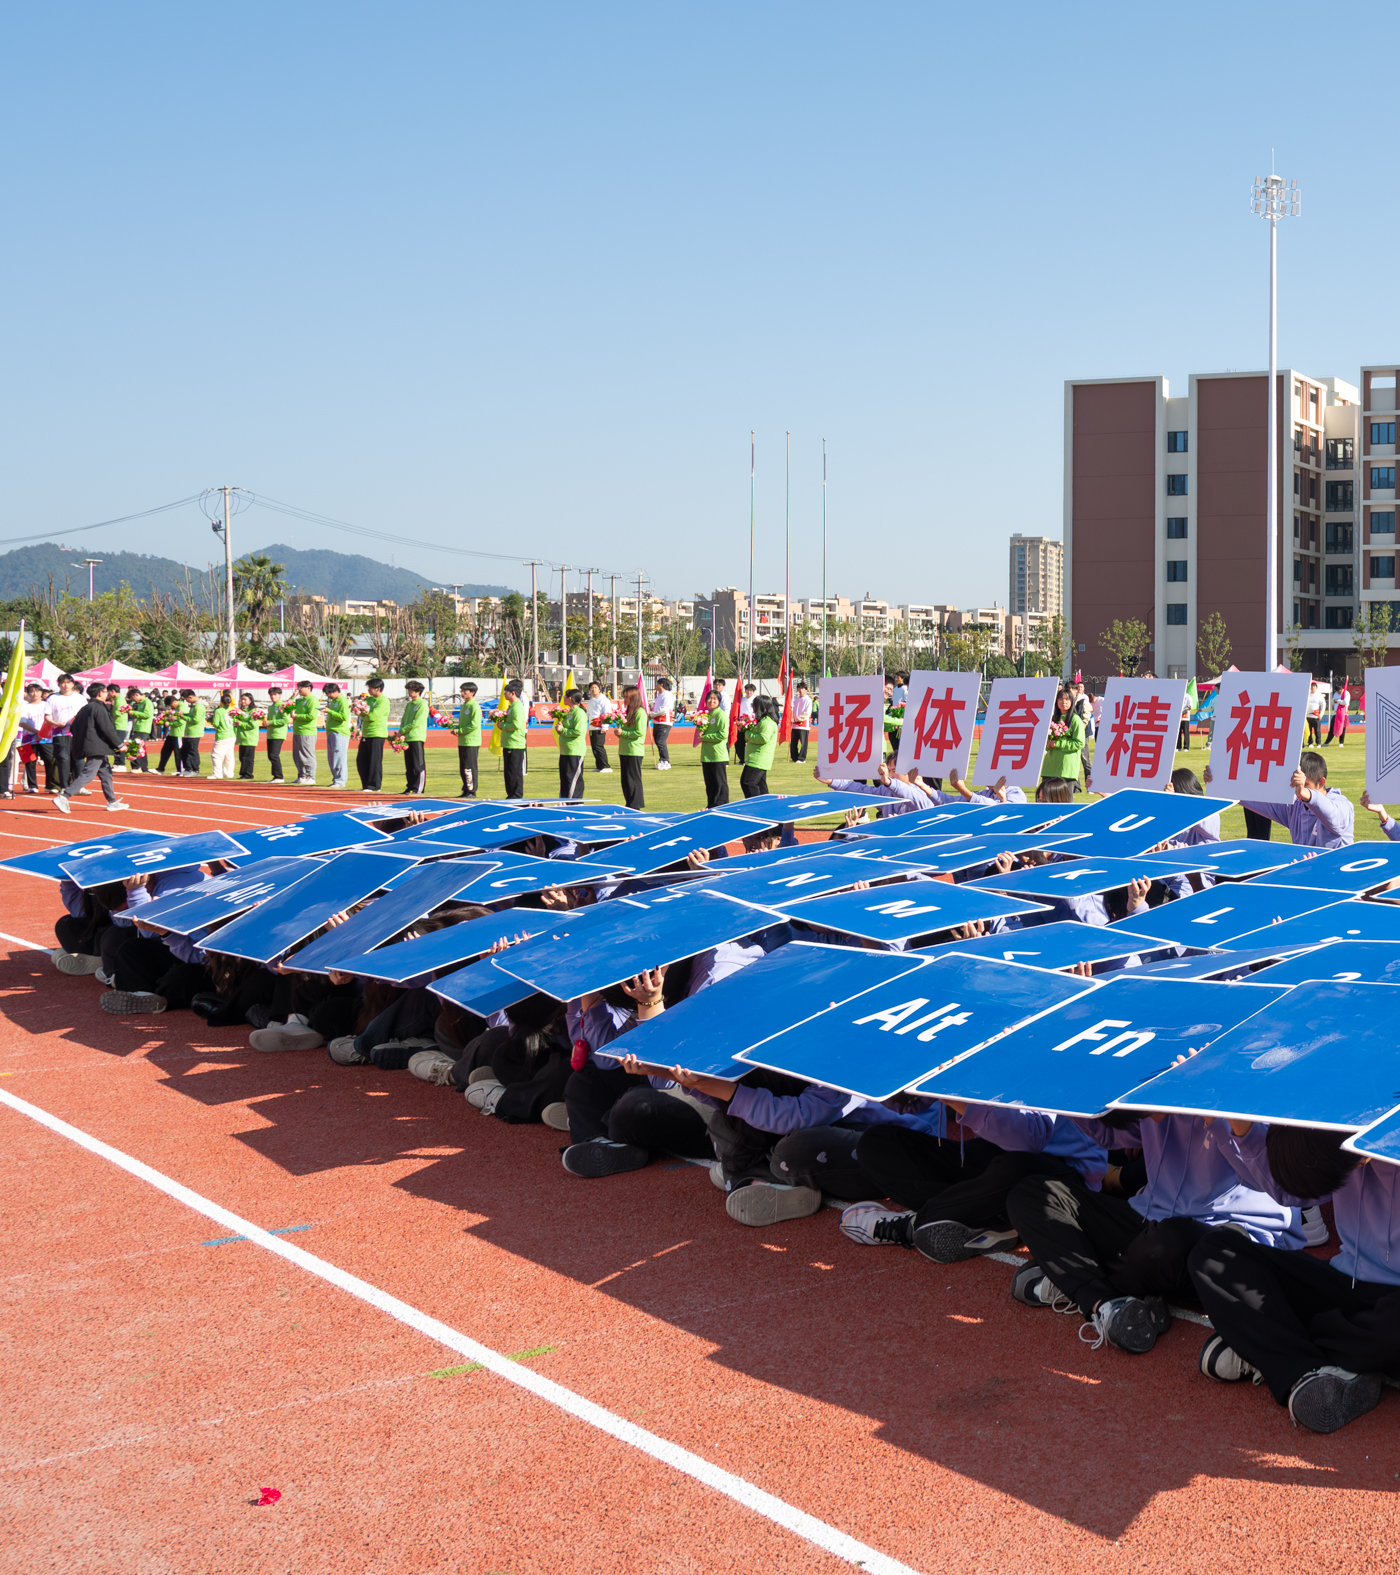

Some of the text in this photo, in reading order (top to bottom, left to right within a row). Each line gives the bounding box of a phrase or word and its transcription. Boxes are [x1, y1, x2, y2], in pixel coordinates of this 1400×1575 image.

[829, 692, 874, 764] 扬
[914, 686, 966, 762] 体
[991, 693, 1045, 770] 育
[1106, 695, 1172, 779] 精
[1226, 689, 1293, 783] 神
[788, 800, 830, 810] R
[981, 814, 1024, 827] Y
[1108, 813, 1156, 833] U
[648, 835, 693, 851] F
[767, 872, 833, 887] N
[1048, 868, 1108, 880] K
[215, 882, 276, 905] Alt
[864, 899, 942, 919] M
[1191, 906, 1235, 925] L
[851, 997, 974, 1042] Alt
[1051, 1018, 1156, 1058] Fn
